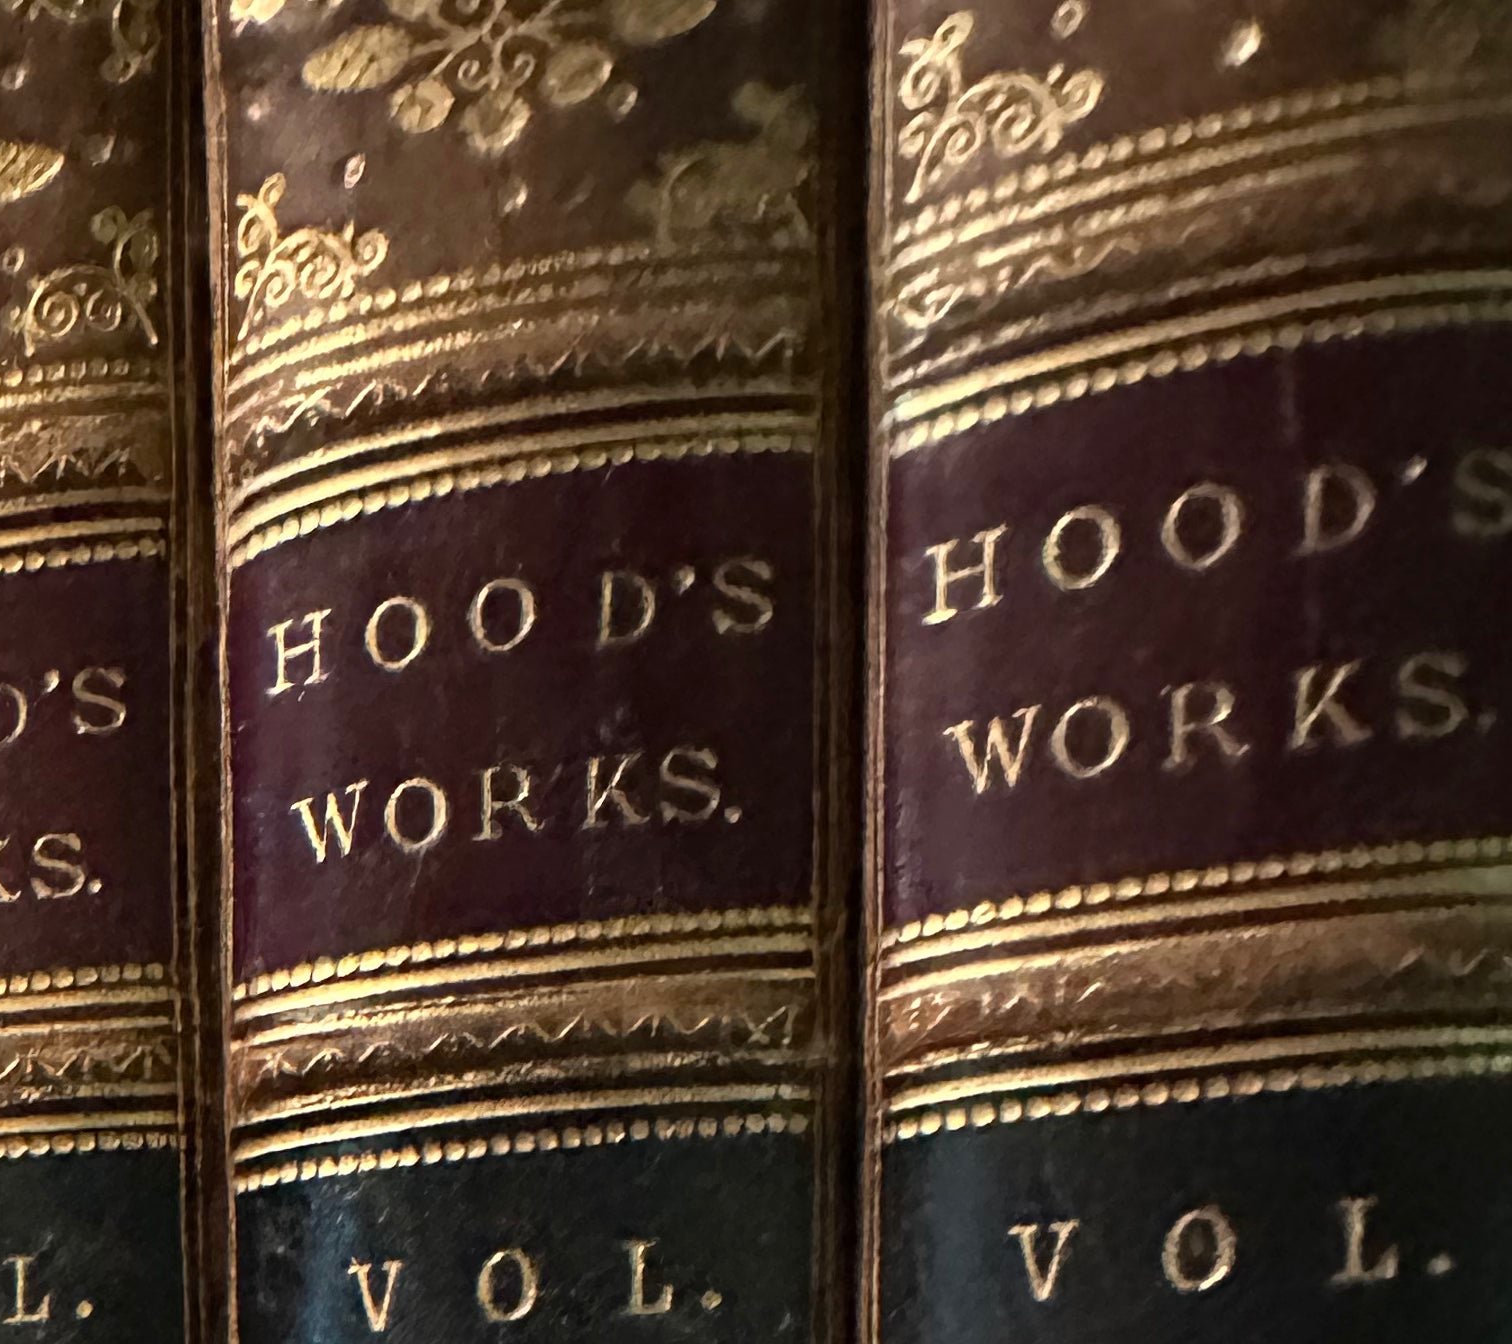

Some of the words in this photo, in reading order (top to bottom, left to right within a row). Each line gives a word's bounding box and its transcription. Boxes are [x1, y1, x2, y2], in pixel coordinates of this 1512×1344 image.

[921, 446, 1512, 626] HOOD'S
[265, 554, 776, 697] HOOD'S
[943, 650, 1496, 796] WORKS.
[290, 746, 743, 865] WORKS.
[346, 1237, 724, 1333] VOL.
[1007, 1195, 1455, 1302] VOL.
